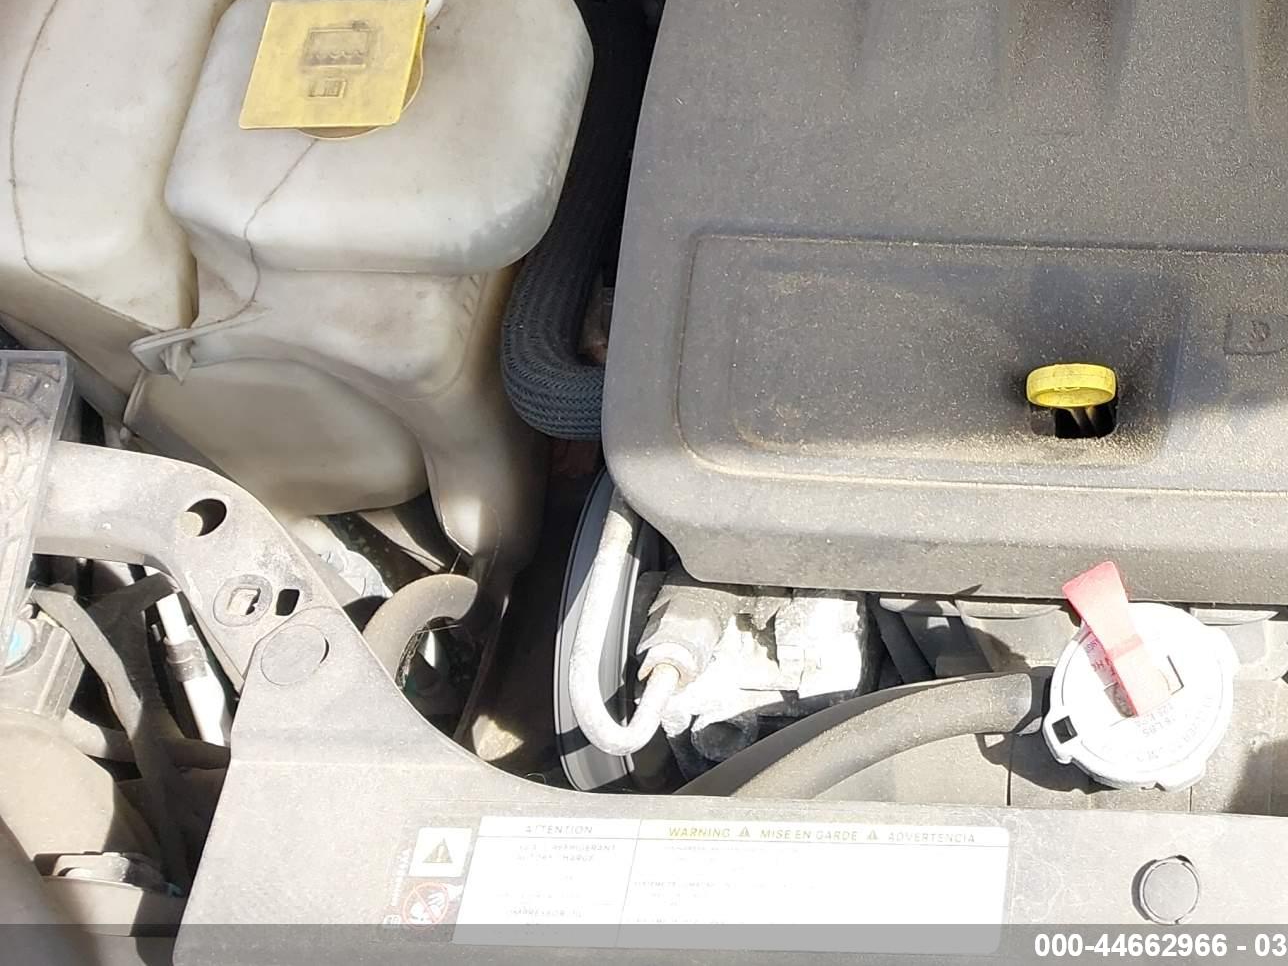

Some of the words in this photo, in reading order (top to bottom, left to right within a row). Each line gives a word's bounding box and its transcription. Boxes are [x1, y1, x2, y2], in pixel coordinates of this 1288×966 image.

[525, 824, 594, 835] ATTENTION
[668, 826, 731, 839] WARNING
[759, 827, 795, 840] MISE
[795, 829, 812, 841] EN
[815, 830, 858, 842] GARDE
[886, 831, 976, 844] ADVERTENCIA
